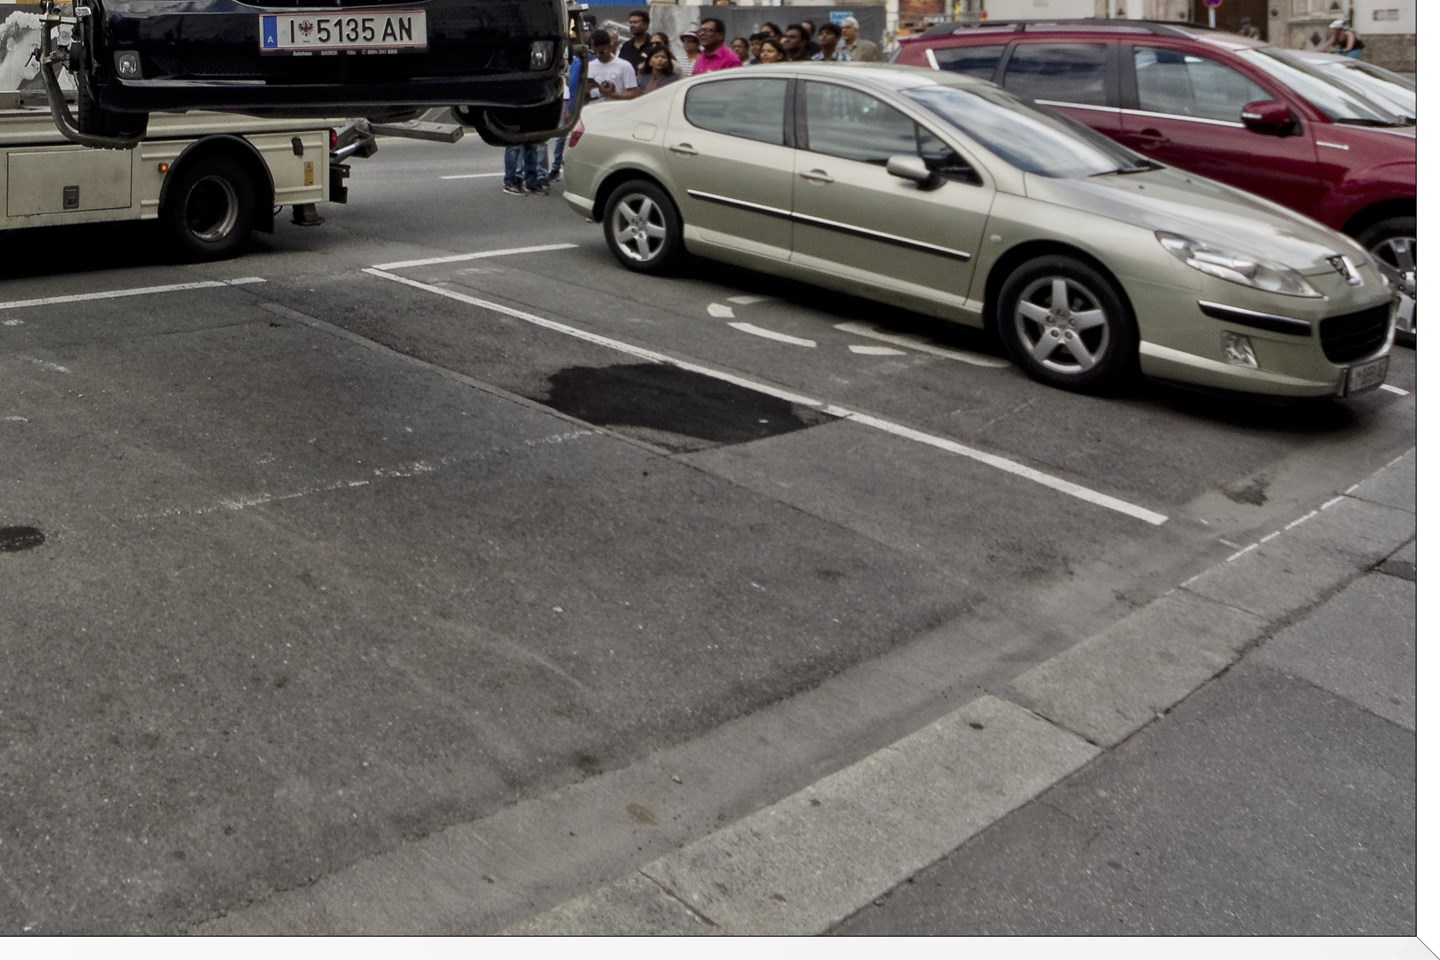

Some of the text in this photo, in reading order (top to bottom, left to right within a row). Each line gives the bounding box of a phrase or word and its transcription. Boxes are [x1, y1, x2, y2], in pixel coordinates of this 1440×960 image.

[290, 17, 412, 44] I 5135 AN
